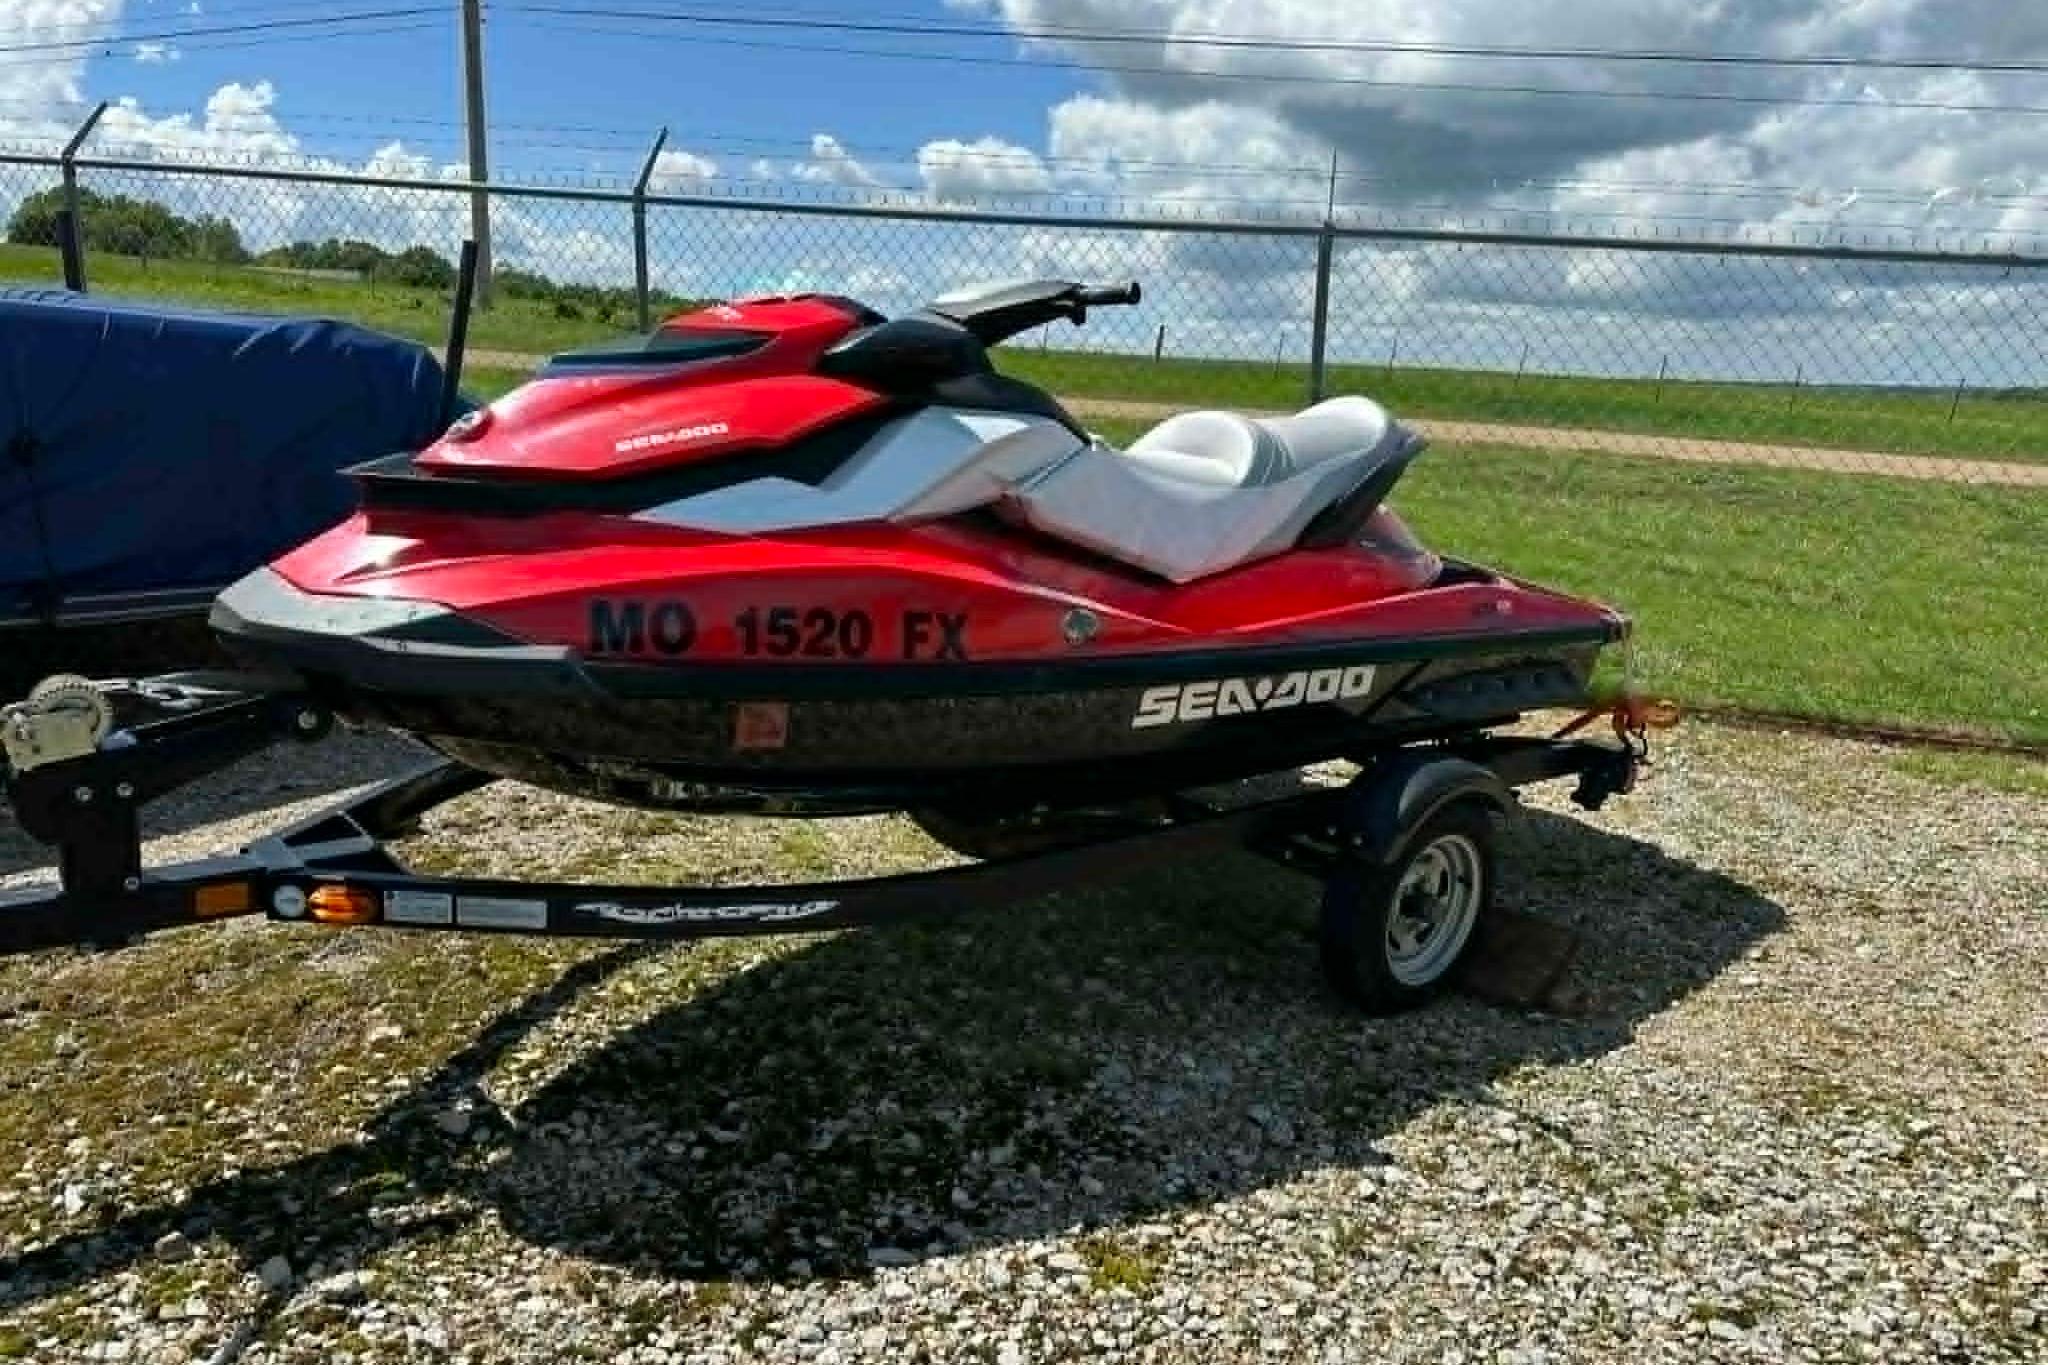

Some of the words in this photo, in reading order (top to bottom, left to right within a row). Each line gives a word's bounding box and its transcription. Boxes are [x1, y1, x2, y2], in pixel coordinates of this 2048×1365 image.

[590, 600, 696, 656] MO
[734, 606, 873, 658] 1520
[903, 610, 968, 661] FX
